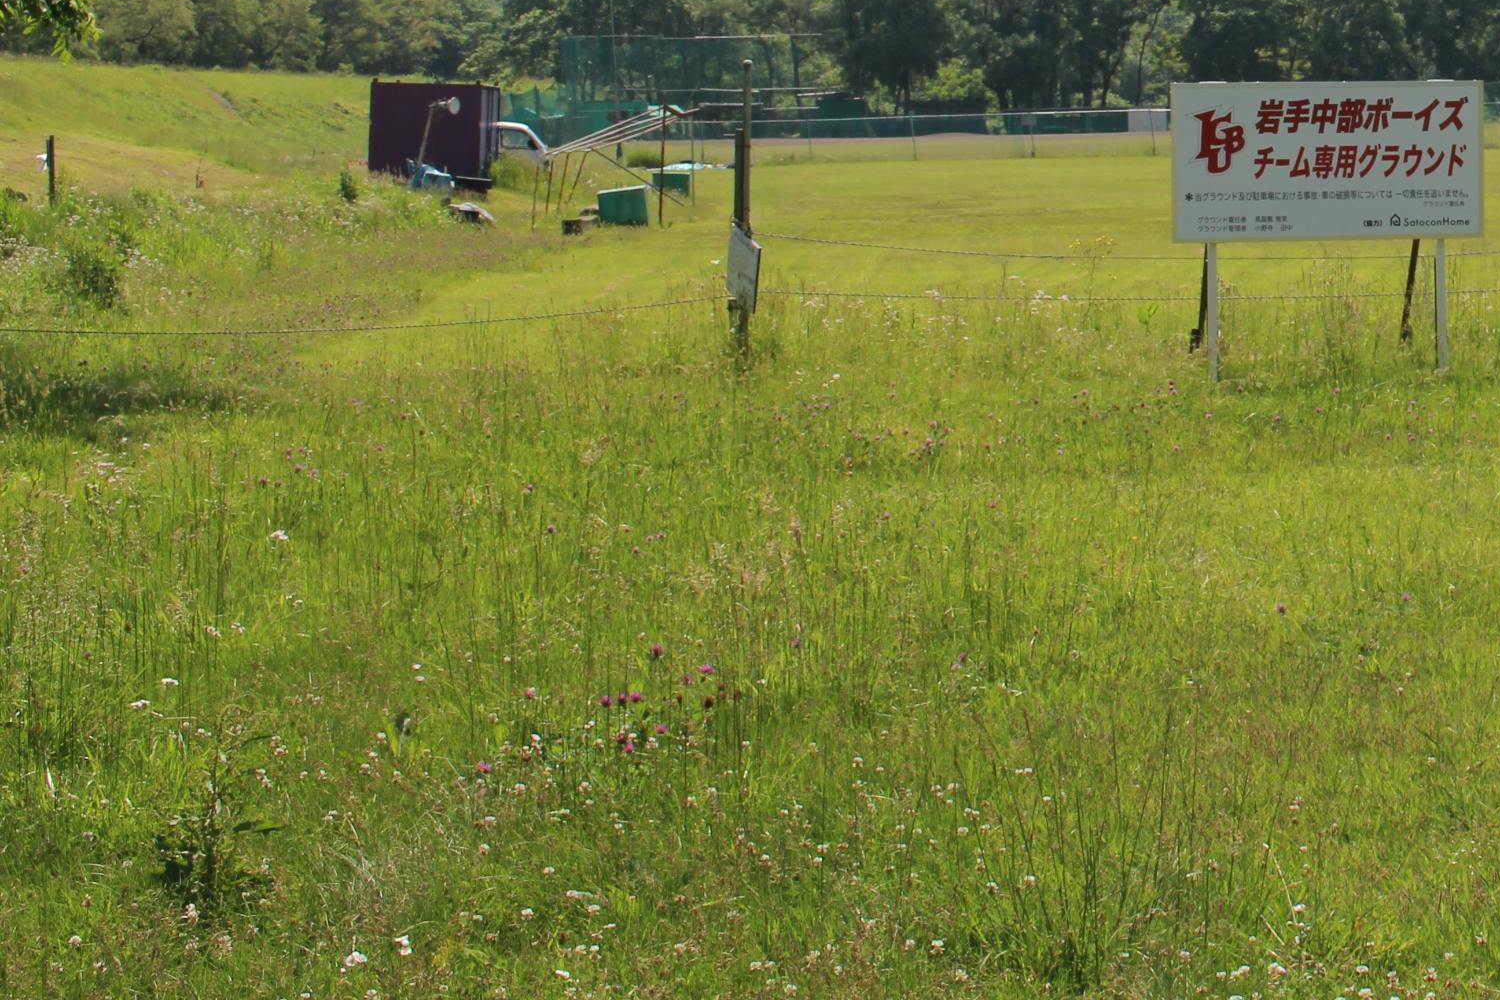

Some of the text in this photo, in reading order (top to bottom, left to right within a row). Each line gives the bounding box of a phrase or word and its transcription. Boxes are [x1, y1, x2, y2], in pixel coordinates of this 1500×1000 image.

[1255, 97, 1469, 134] 岩手中部ボーイズ
[1254, 144, 1467, 179] チーム専用グラウンド
[1403, 217, 1470, 227] SatoconHome
